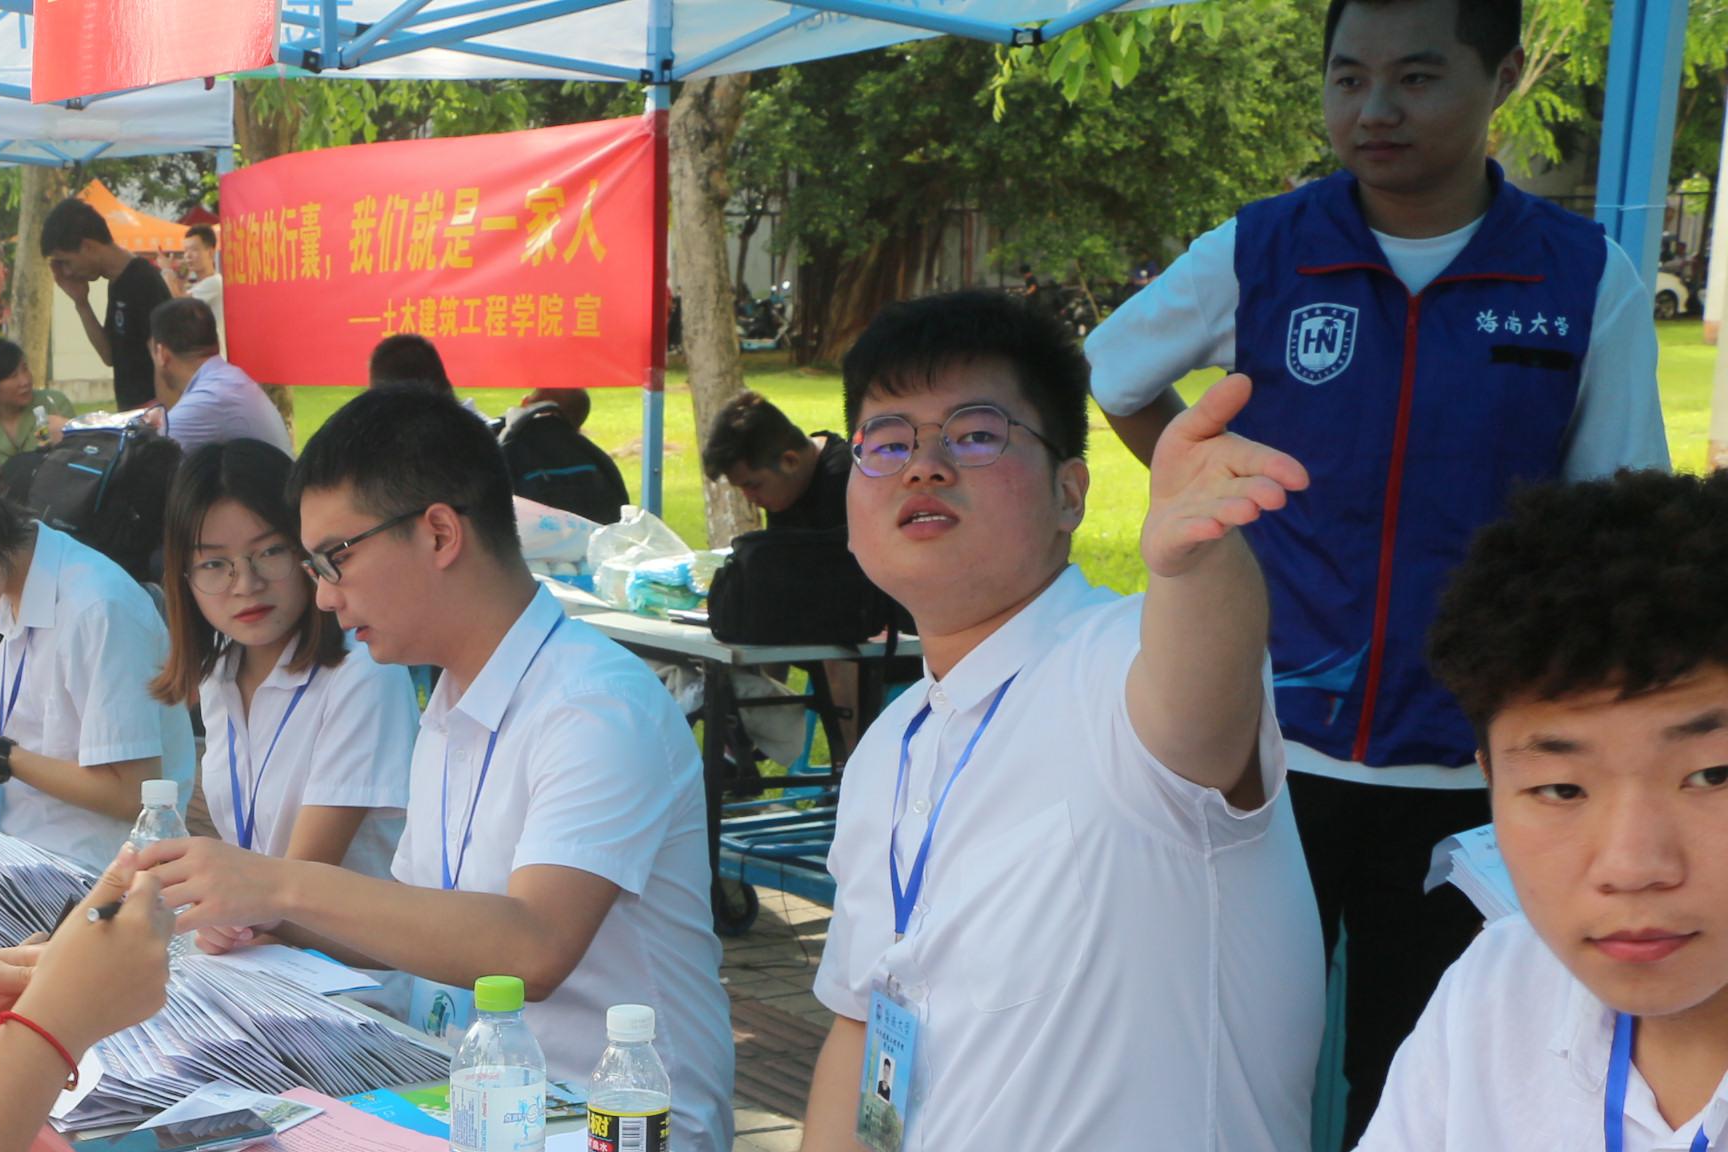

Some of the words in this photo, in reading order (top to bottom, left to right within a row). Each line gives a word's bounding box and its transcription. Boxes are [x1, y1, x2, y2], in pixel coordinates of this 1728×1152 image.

[573, 292, 602, 337] 宣
[1476, 309, 1569, 336] 海南大学
